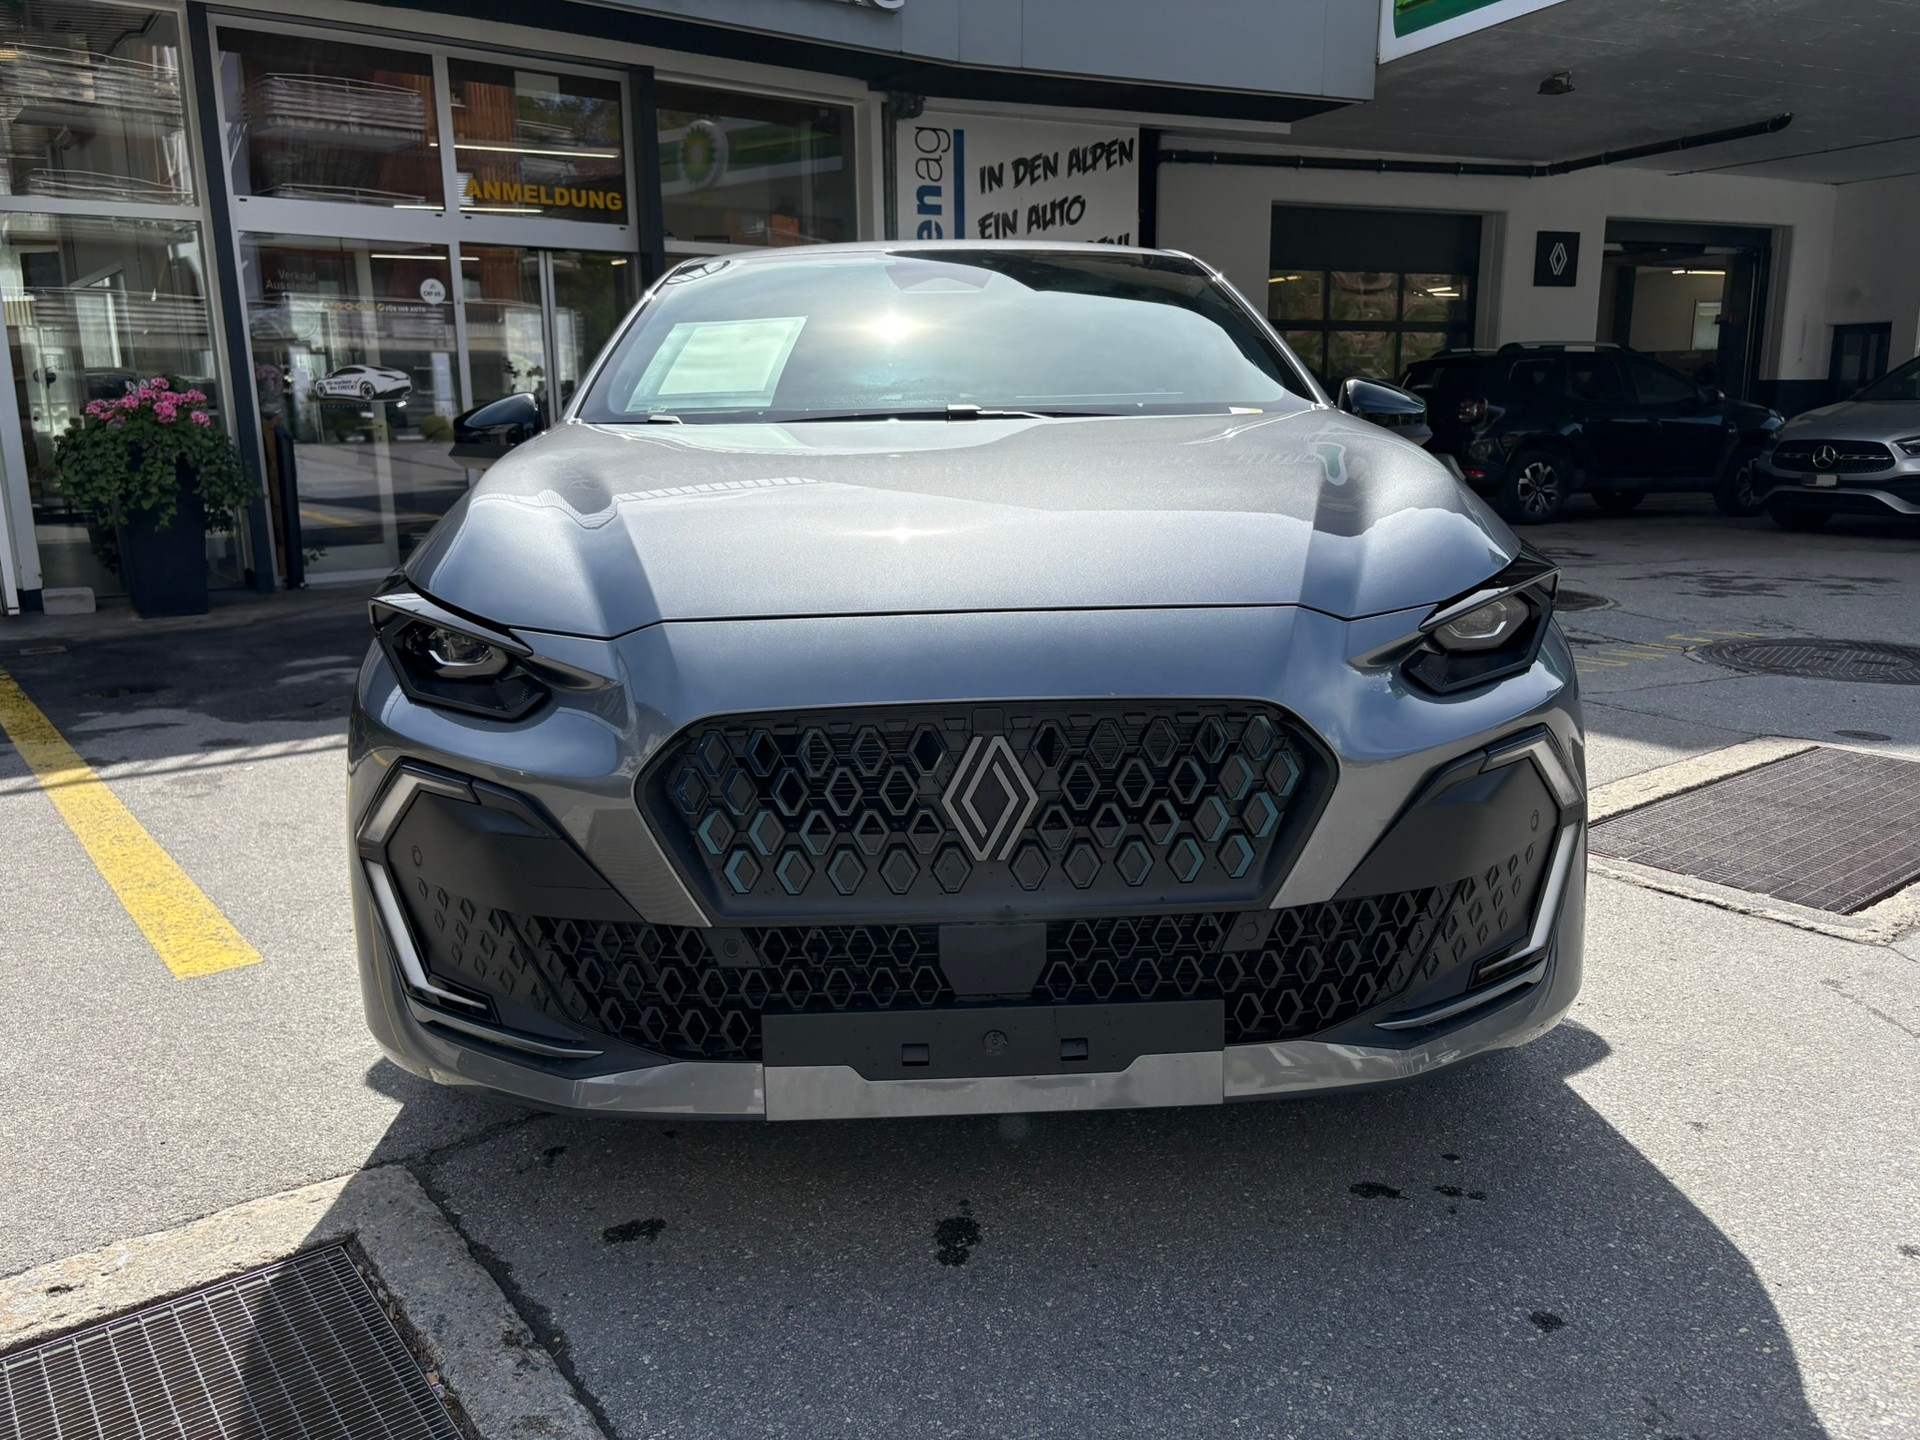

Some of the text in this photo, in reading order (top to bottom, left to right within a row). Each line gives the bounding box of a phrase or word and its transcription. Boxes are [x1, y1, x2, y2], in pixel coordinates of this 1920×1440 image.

[979, 137, 1134, 195] IN DEN ALPEN
[464, 178, 623, 211] ANMELDUNG
[978, 194, 1086, 240] EIN AUTO
[278, 269, 316, 282] Verkauf
[386, 304, 397, 312] FÜR
